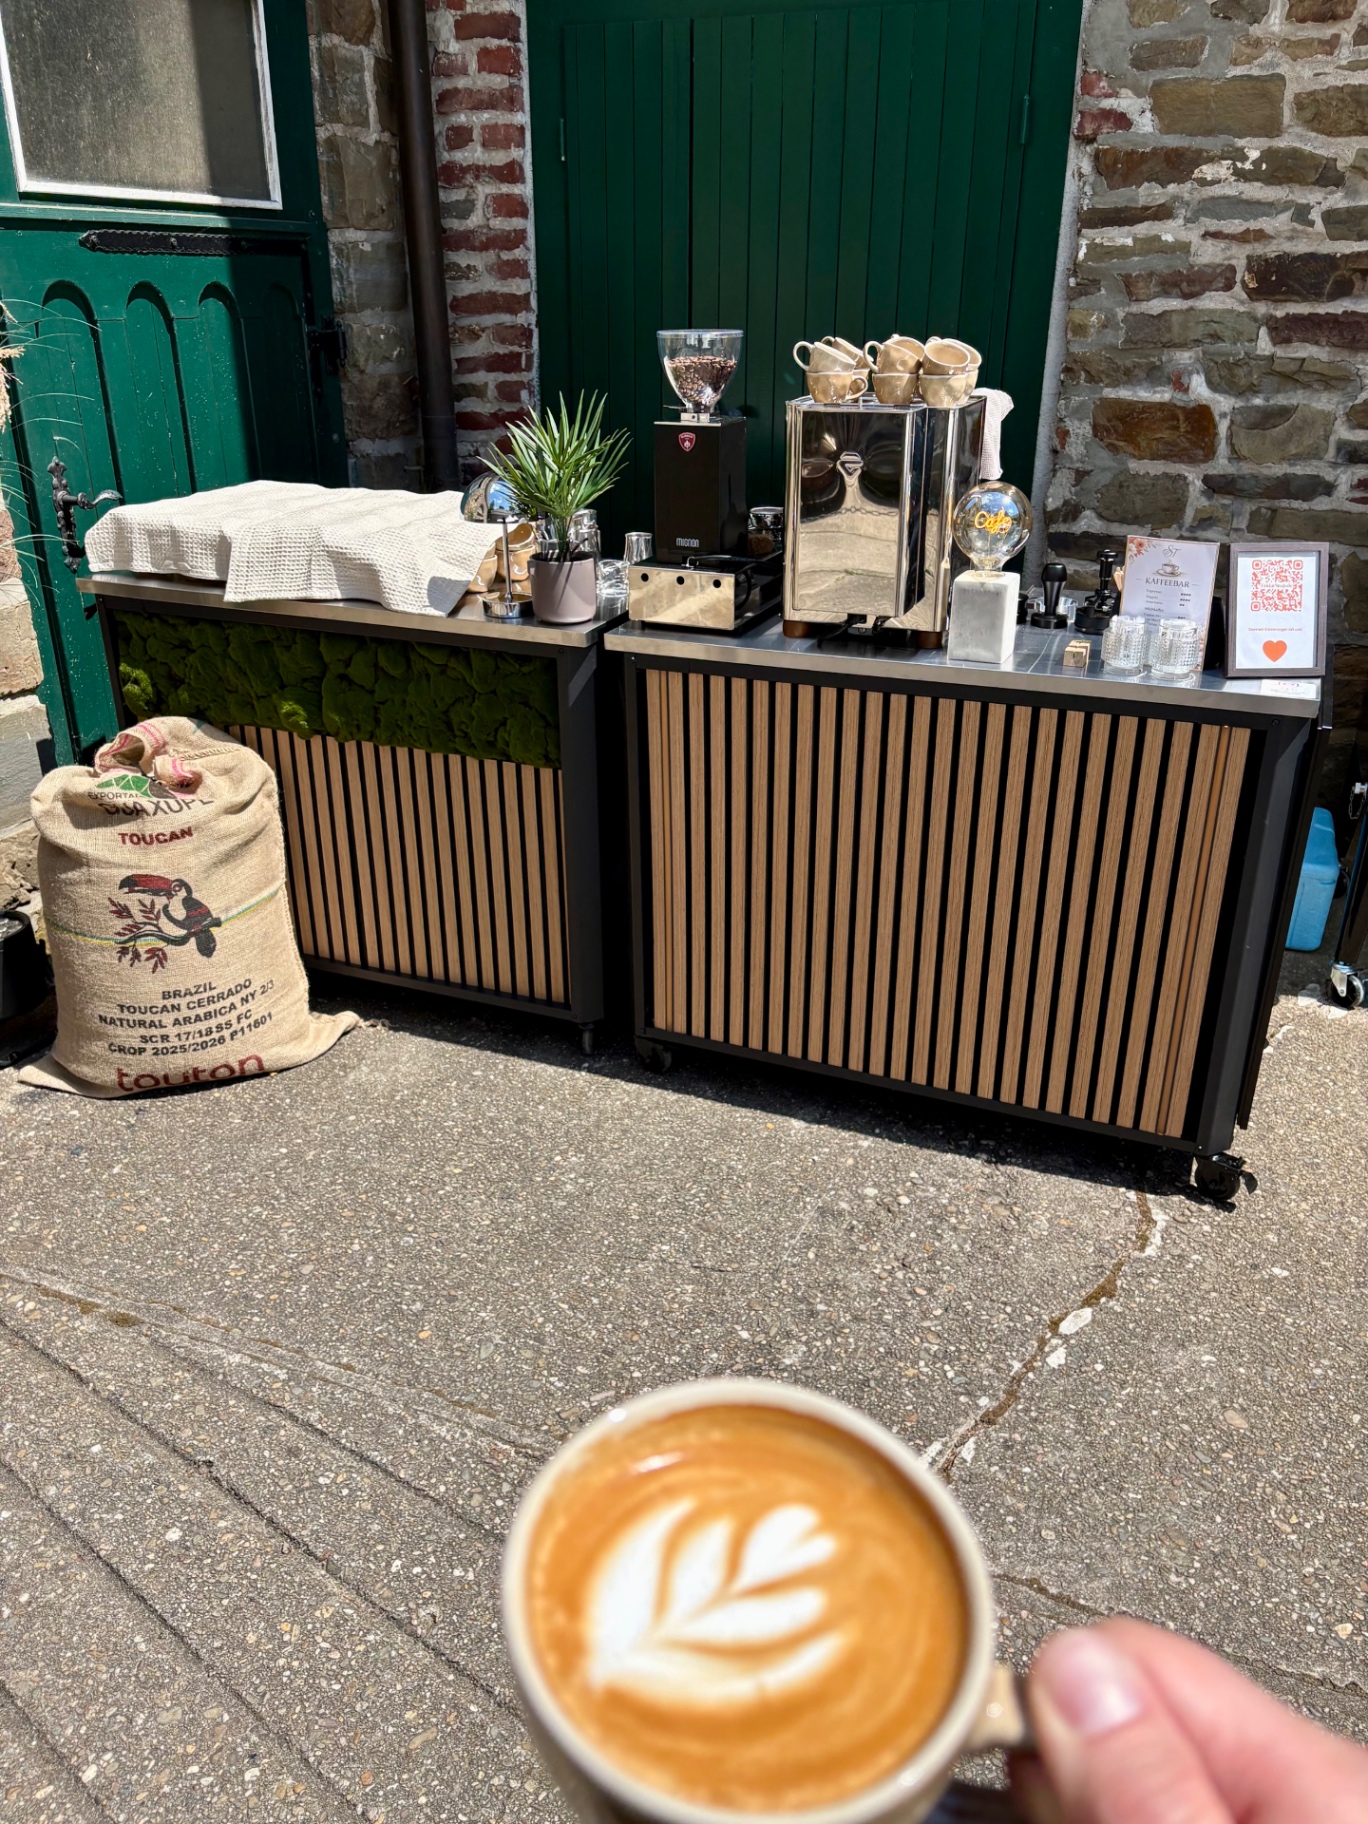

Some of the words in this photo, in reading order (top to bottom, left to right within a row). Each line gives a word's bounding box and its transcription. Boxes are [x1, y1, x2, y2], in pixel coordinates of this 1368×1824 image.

[1145, 577, 1190, 588] KAFFEEBAR
[118, 826, 194, 846] TOUCAN
[98, 1014, 168, 1029] NATURAL
[172, 1002, 237, 1027] ARABICA
[240, 990, 257, 1006] NY
[260, 979, 274, 995] 2/3
[117, 1003, 181, 1015] TOUCAN
[186, 978, 252, 1010] CERRADO
[161, 981, 217, 1000] BRAZIL
[140, 1034, 170, 1043] SCR
[236, 1009, 252, 1024] FC
[108, 1042, 147, 1056] CROP
[152, 1035, 226, 1056] 2025/2026
[116, 1053, 265, 1092] touton
